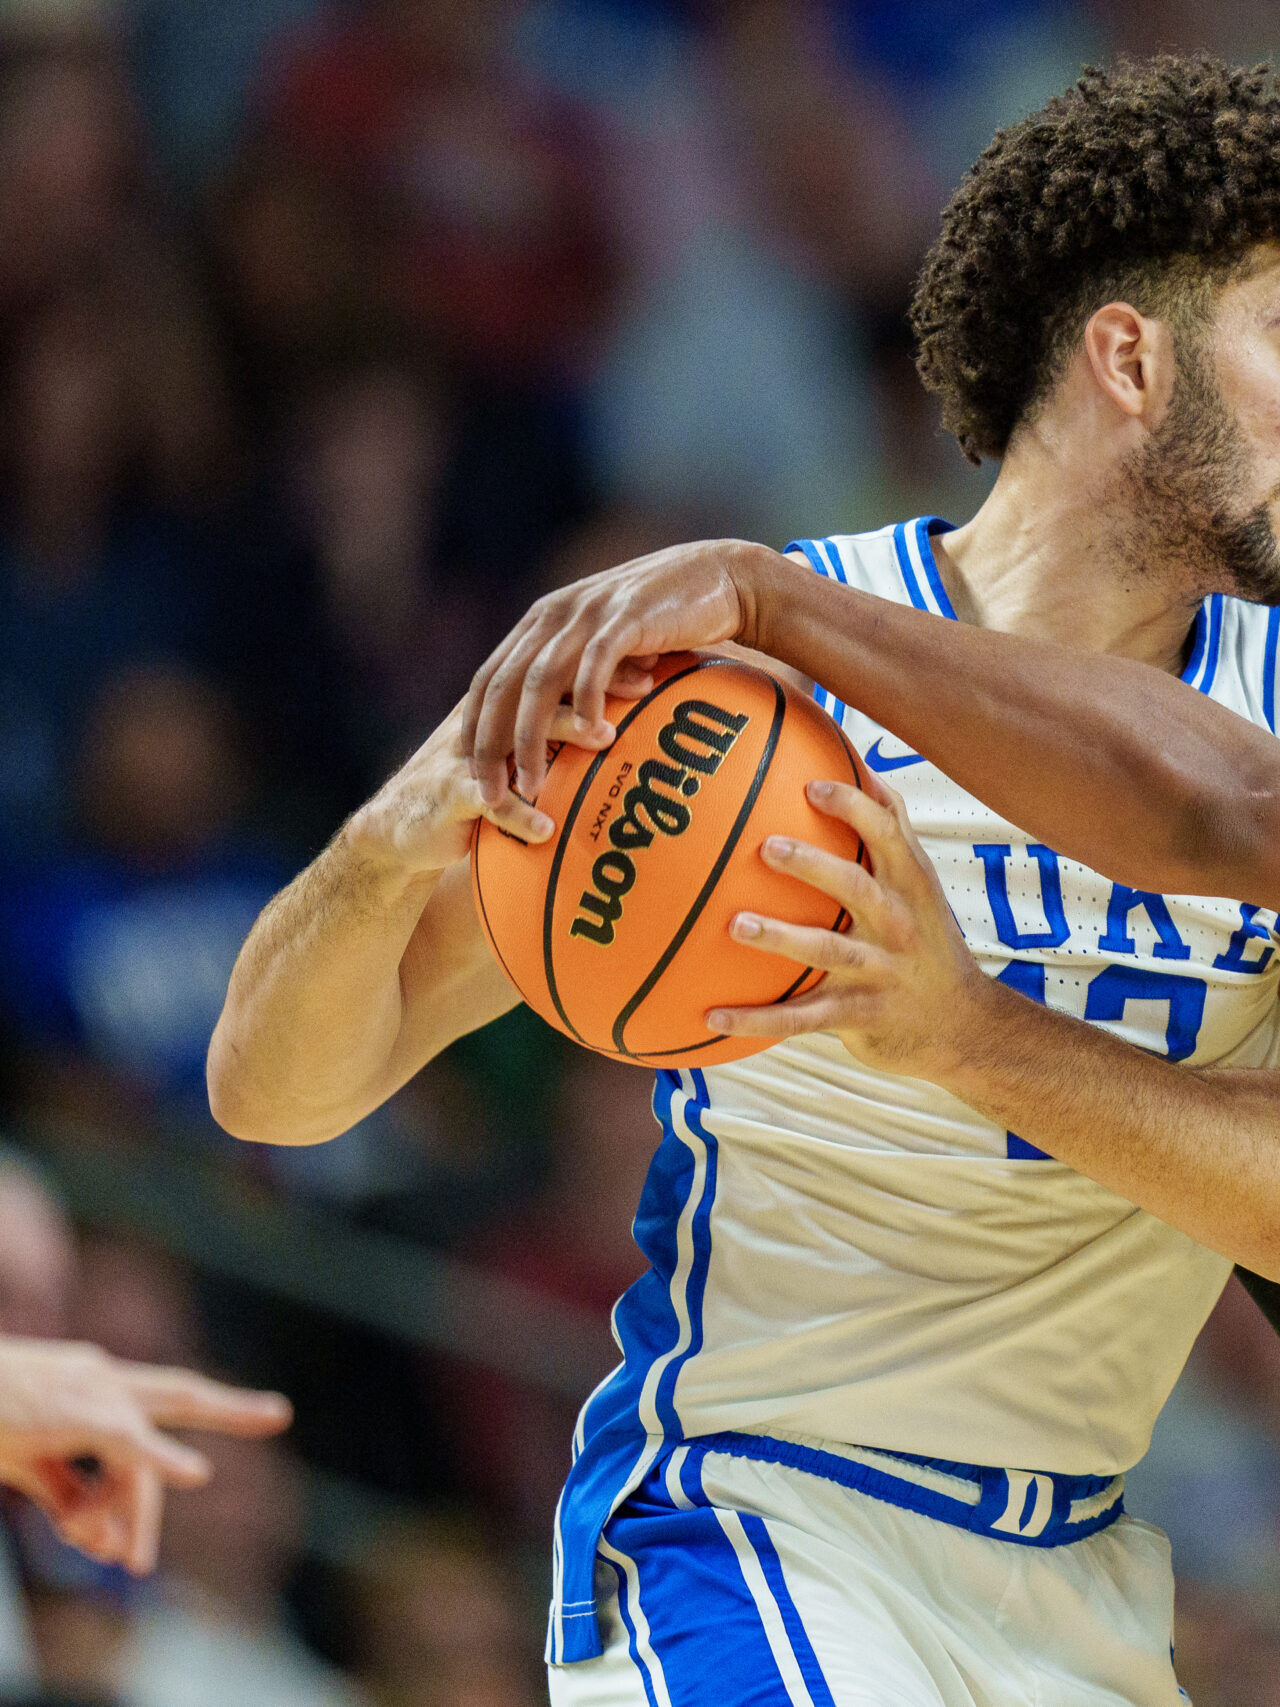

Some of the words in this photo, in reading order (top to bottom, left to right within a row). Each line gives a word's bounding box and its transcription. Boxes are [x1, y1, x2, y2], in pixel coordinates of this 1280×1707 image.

[609, 762, 632, 798] EVO
[569, 699, 750, 947] Wilson
[590, 802, 612, 842] NXT
[990, 1467, 1054, 1538] D
